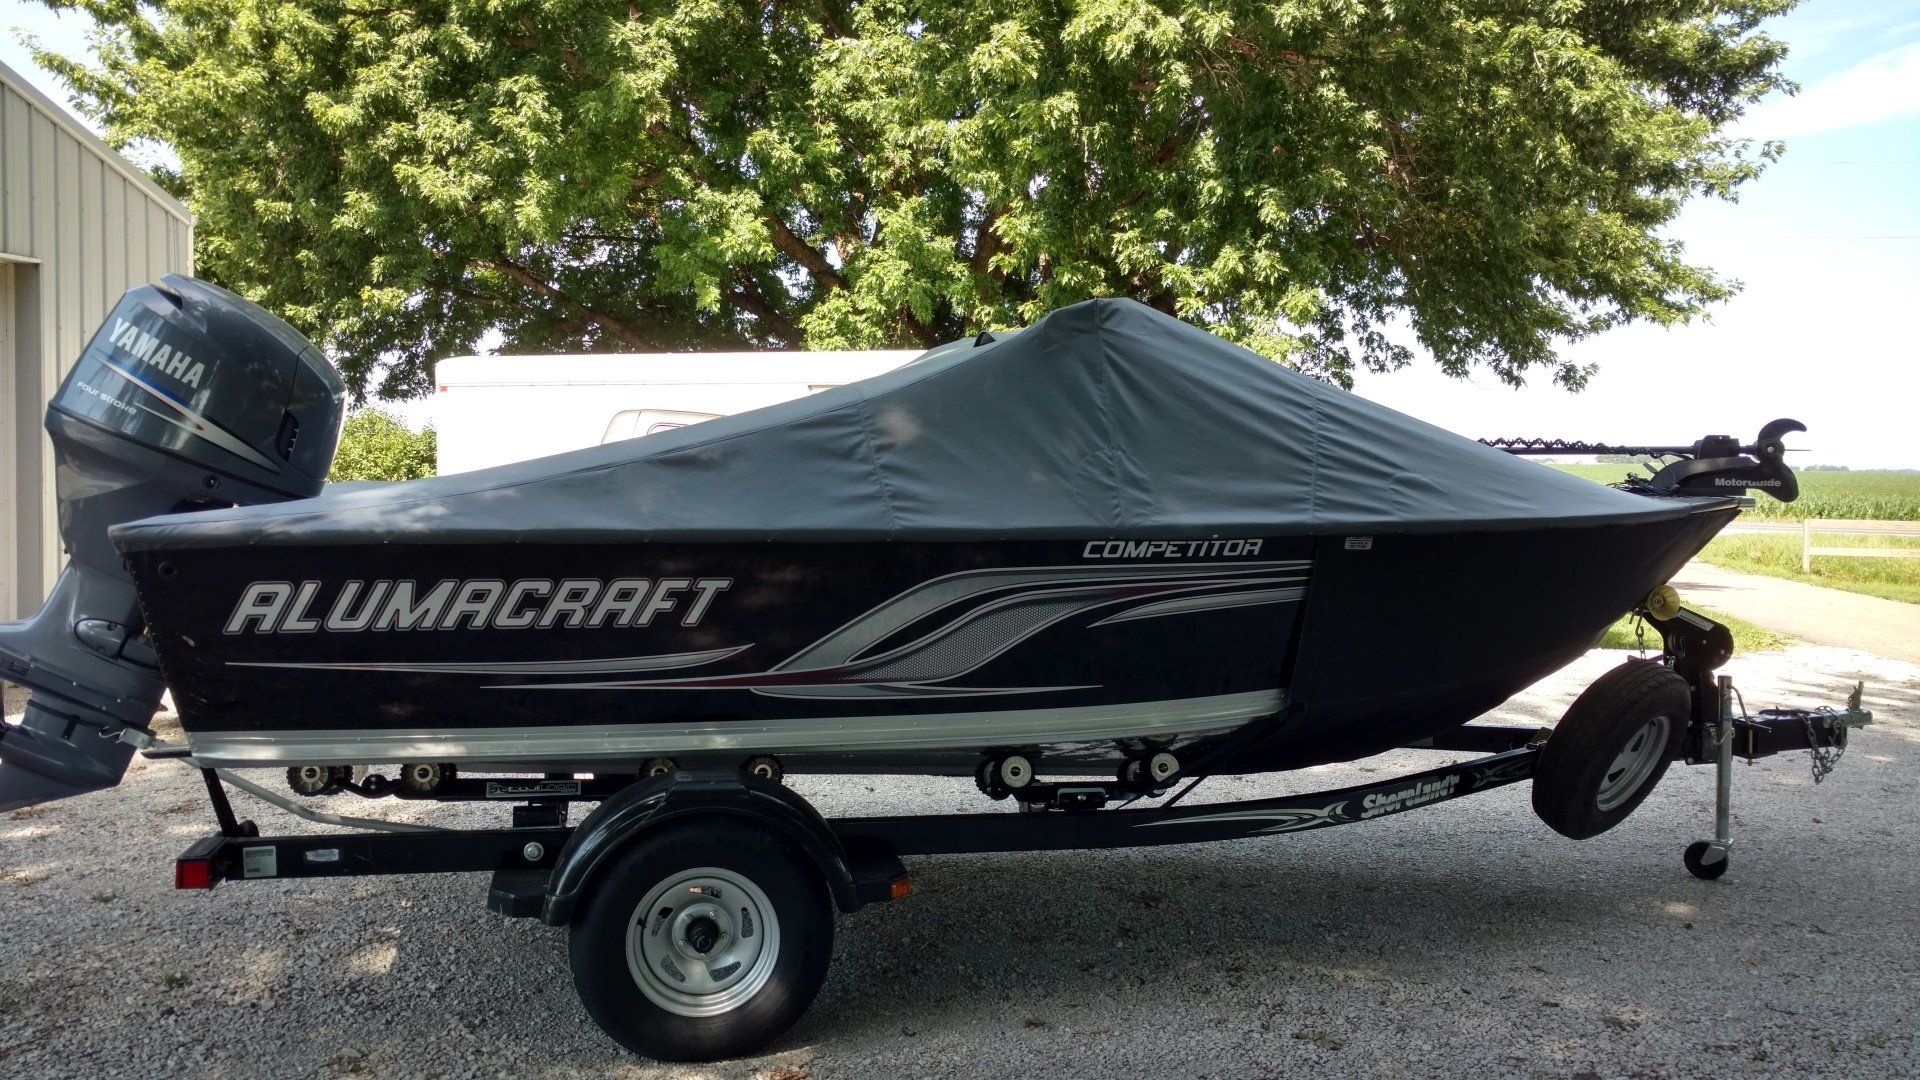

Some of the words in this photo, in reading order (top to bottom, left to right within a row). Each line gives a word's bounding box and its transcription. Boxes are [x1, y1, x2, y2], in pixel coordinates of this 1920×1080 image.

[109, 318, 205, 388] YAMAHA
[1083, 538, 1264, 558] COMPETITOR
[223, 578, 733, 634] ALUMACRAFT
